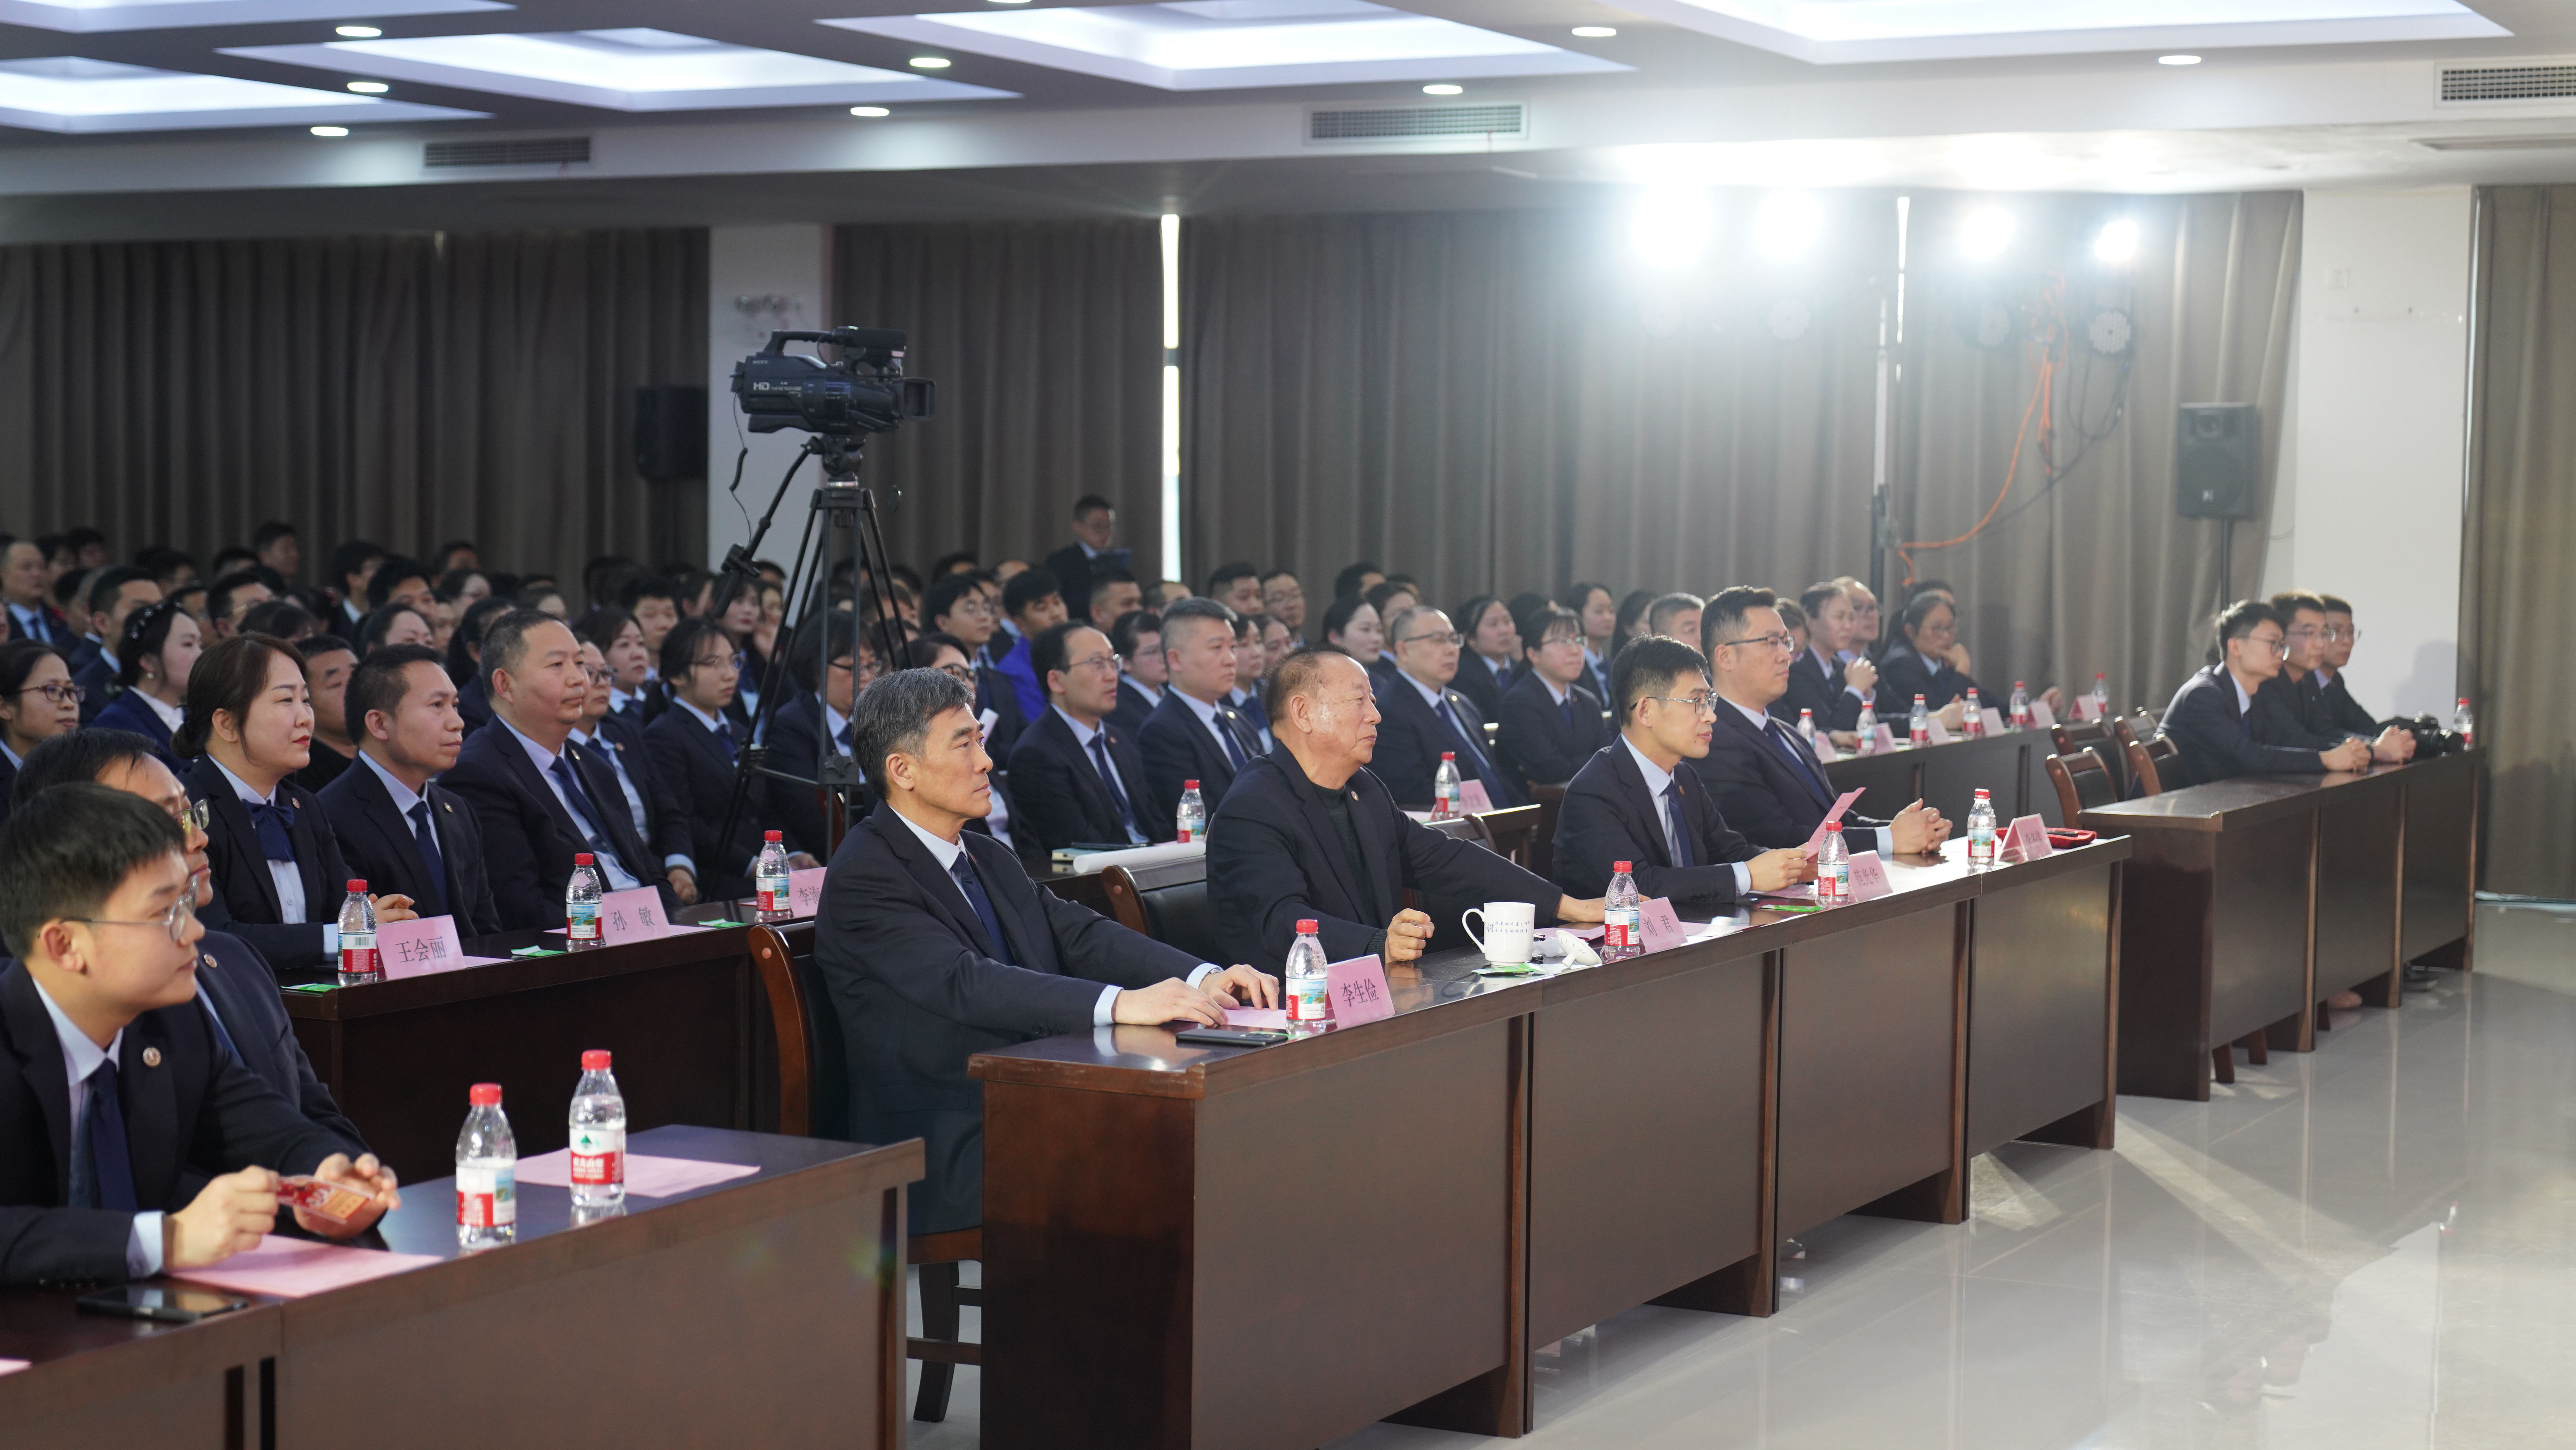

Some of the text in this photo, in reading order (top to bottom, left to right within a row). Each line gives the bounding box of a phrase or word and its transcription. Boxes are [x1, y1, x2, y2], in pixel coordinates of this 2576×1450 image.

[753, 381, 770, 391] HD
[395, 936, 447, 963] 王会丽
[1340, 978, 1380, 1007] 李生俭
